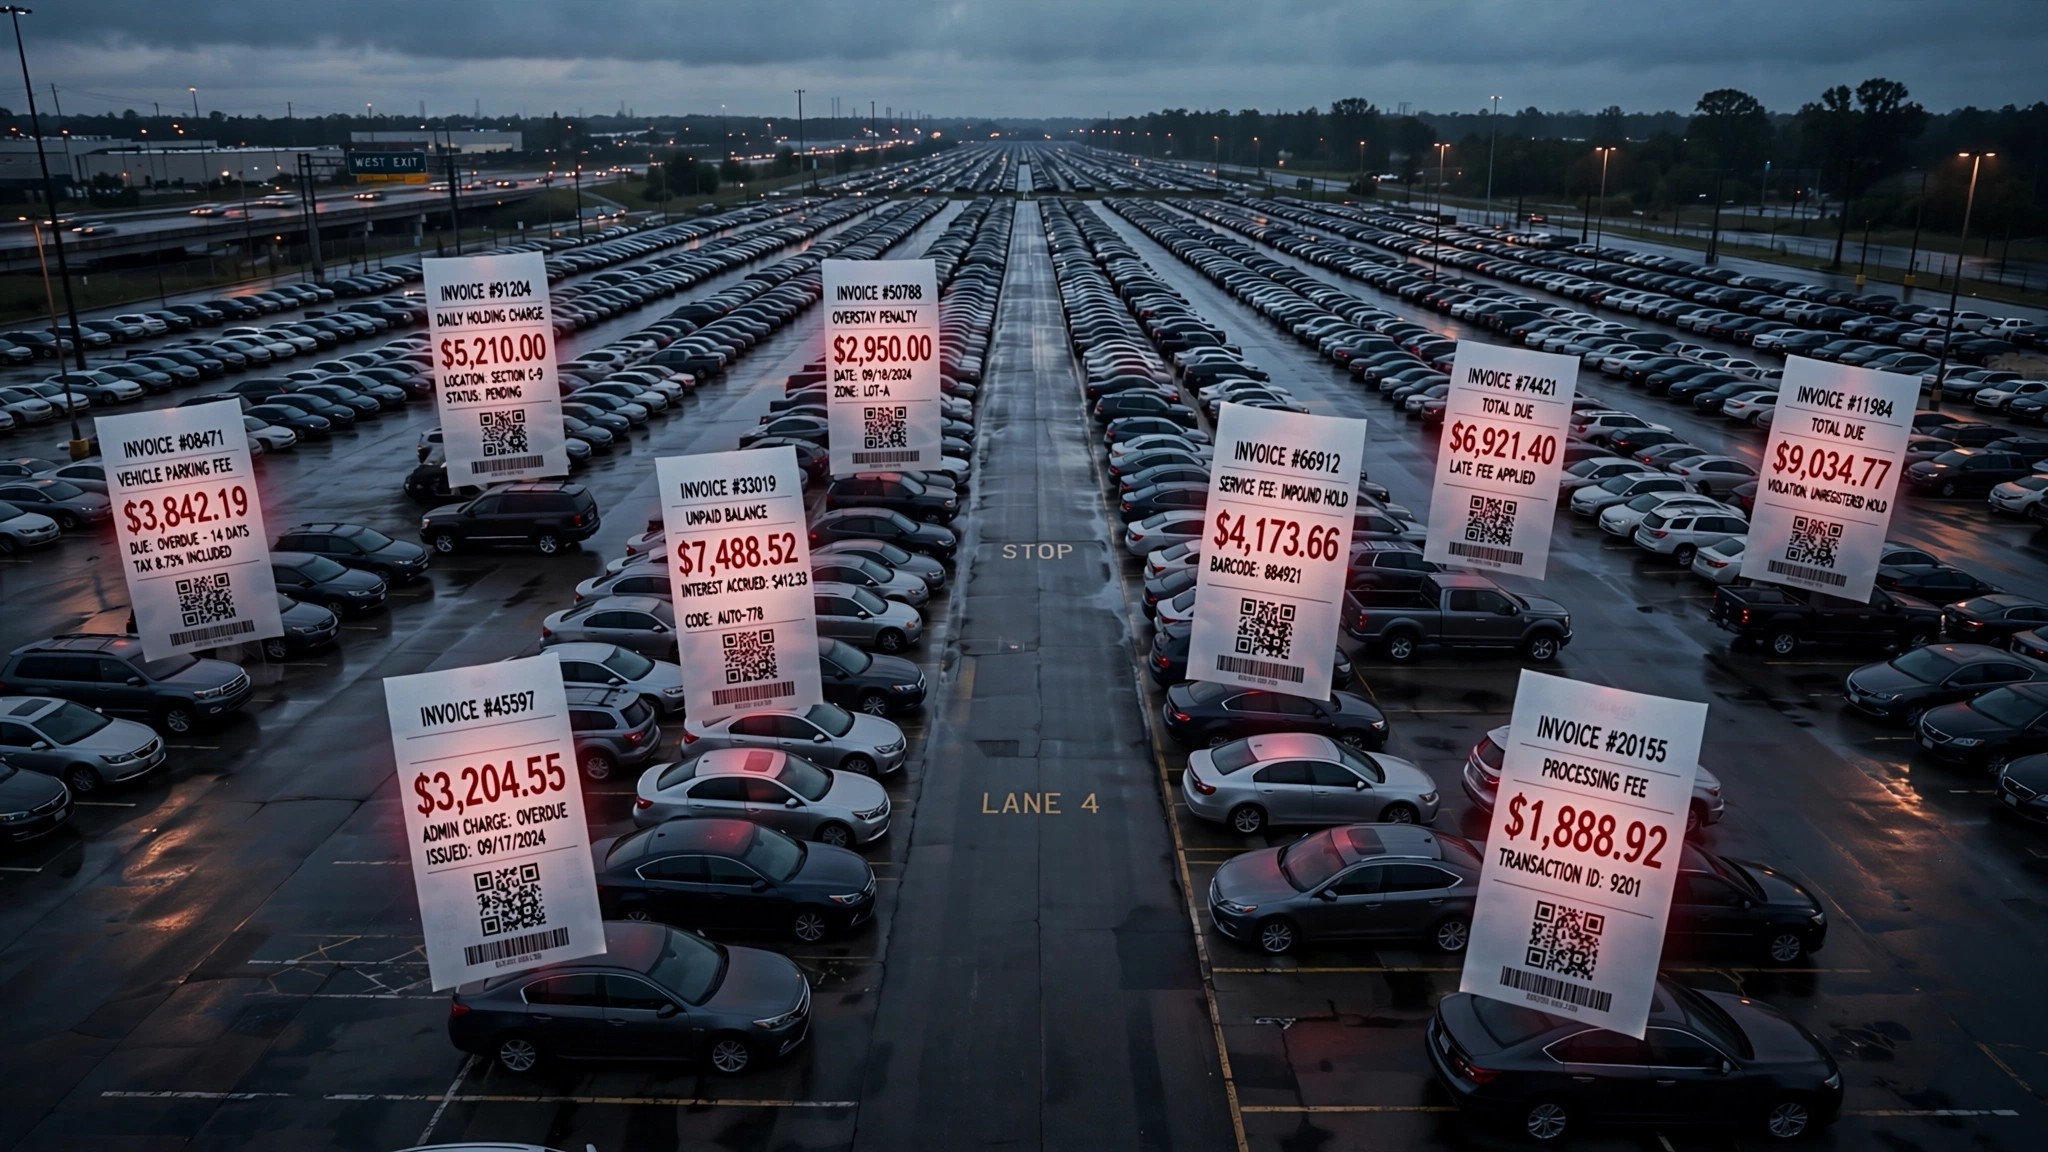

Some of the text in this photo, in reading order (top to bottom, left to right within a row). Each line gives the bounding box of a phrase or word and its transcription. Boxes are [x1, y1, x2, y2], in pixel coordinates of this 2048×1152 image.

[355, 158, 418, 167] WEST EXIT
[441, 281, 531, 301] INVOICE #91204
[837, 285, 922, 300] INVOICE #50788
[437, 307, 544, 327] DAILY HOLDING CHARGE
[833, 310, 917, 324] OVERSTAY PENALTY
[441, 333, 546, 369] $5,210.00
[834, 335, 931, 367] $2,950.00
[444, 368, 543, 387] LOCATION: SECTION C-9
[834, 369, 912, 382] DATE: 09/18/2024
[1468, 368, 1556, 396] INVOICE #74421
[447, 386, 521, 404] STATUS: PENDING
[835, 385, 890, 397] ZONE: LOT-A
[1797, 386, 1893, 418] INVOICE #11984
[1483, 398, 1534, 419] TOTAL DUE
[1450, 420, 1556, 465] $6,921.40
[1812, 418, 1866, 441] TOTAL DUE
[124, 430, 223, 458] INVOICE #08471
[1234, 441, 1340, 474] INVOICE #66912
[117, 458, 233, 487] VEHICLE PARKING FEE
[1450, 460, 1536, 485] LATE FEE APPLIED
[1773, 440, 1892, 490] $9,034.77
[680, 475, 776, 499] INVOICE #33019
[1219, 475, 1255, 495] SERVICE
[1259, 481, 1277, 498] FEE:
[1281, 483, 1321, 504] IMPOUND
[124, 485, 248, 535] $3,842.19
[686, 505, 767, 526] UNPAID BALANCE
[130, 541, 153, 555] DUE:
[158, 533, 199, 551] OVERDUE
[211, 529, 222, 543] 14
[226, 525, 249, 540] DAYS
[1214, 509, 1340, 561] $4,173.66
[133, 545, 232, 573] TAX 8.75% INCLUDED
[678, 532, 798, 577] $7,488.52
[1002, 544, 1073, 560] STOP
[1210, 556, 1301, 584] BARCODE: 884921
[682, 581, 723, 598] INTEREST
[686, 608, 764, 628] CODE: AUTO-778
[421, 691, 534, 727] INVOICE #45597
[1537, 715, 1668, 763] INVOICE #20155
[414, 753, 566, 817] $3,204.55
[1542, 758, 1649, 798] PROCESSING FEE
[982, 792, 1099, 814] LANE 4
[423, 802, 568, 843] ADMIN CHARGE: OVERDUE
[1505, 792, 1668, 869] $1,888.92
[426, 829, 546, 865] ISSUED: 09/17/2024
[1499, 848, 1641, 897] TRANSACTION ID: 9201
